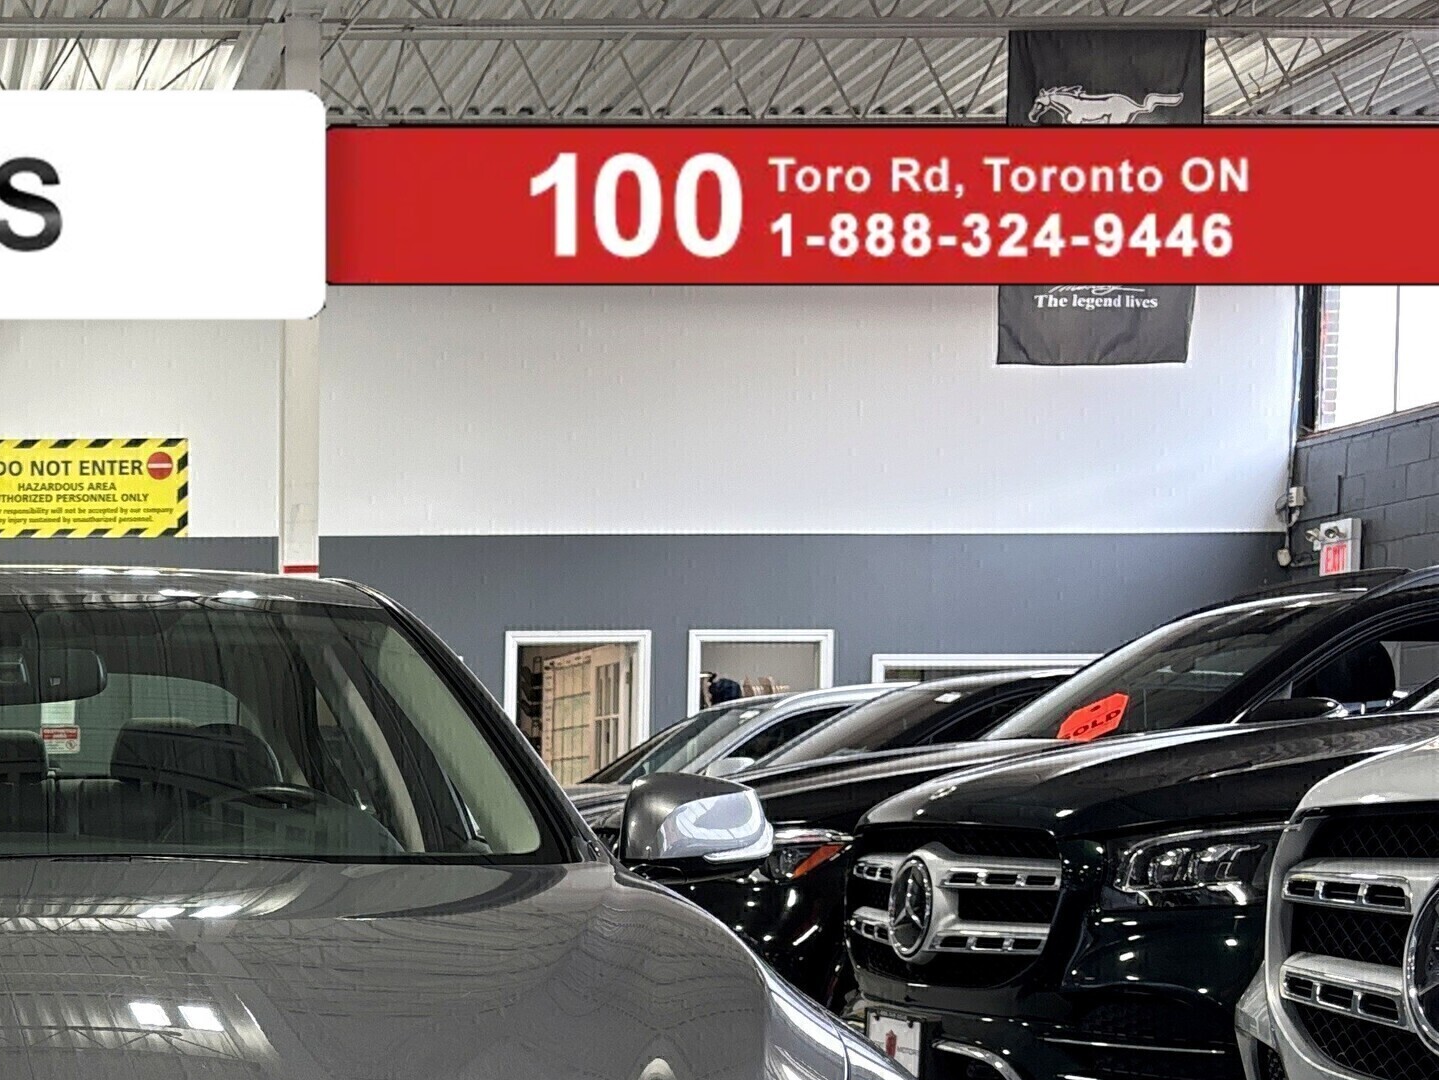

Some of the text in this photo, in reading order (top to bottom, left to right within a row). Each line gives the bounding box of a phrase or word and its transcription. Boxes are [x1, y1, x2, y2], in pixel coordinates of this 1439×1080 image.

[1034, 294, 1158, 310] The legend lives
[30, 461, 72, 476] NOT
[80, 460, 143, 475] ENTER
[17, 482, 117, 491] HAZARDOUS AREA
[56, 494, 118, 502] PERSONNEL
[121, 493, 149, 502] ONLY
[1325, 544, 1347, 574] EXIT
